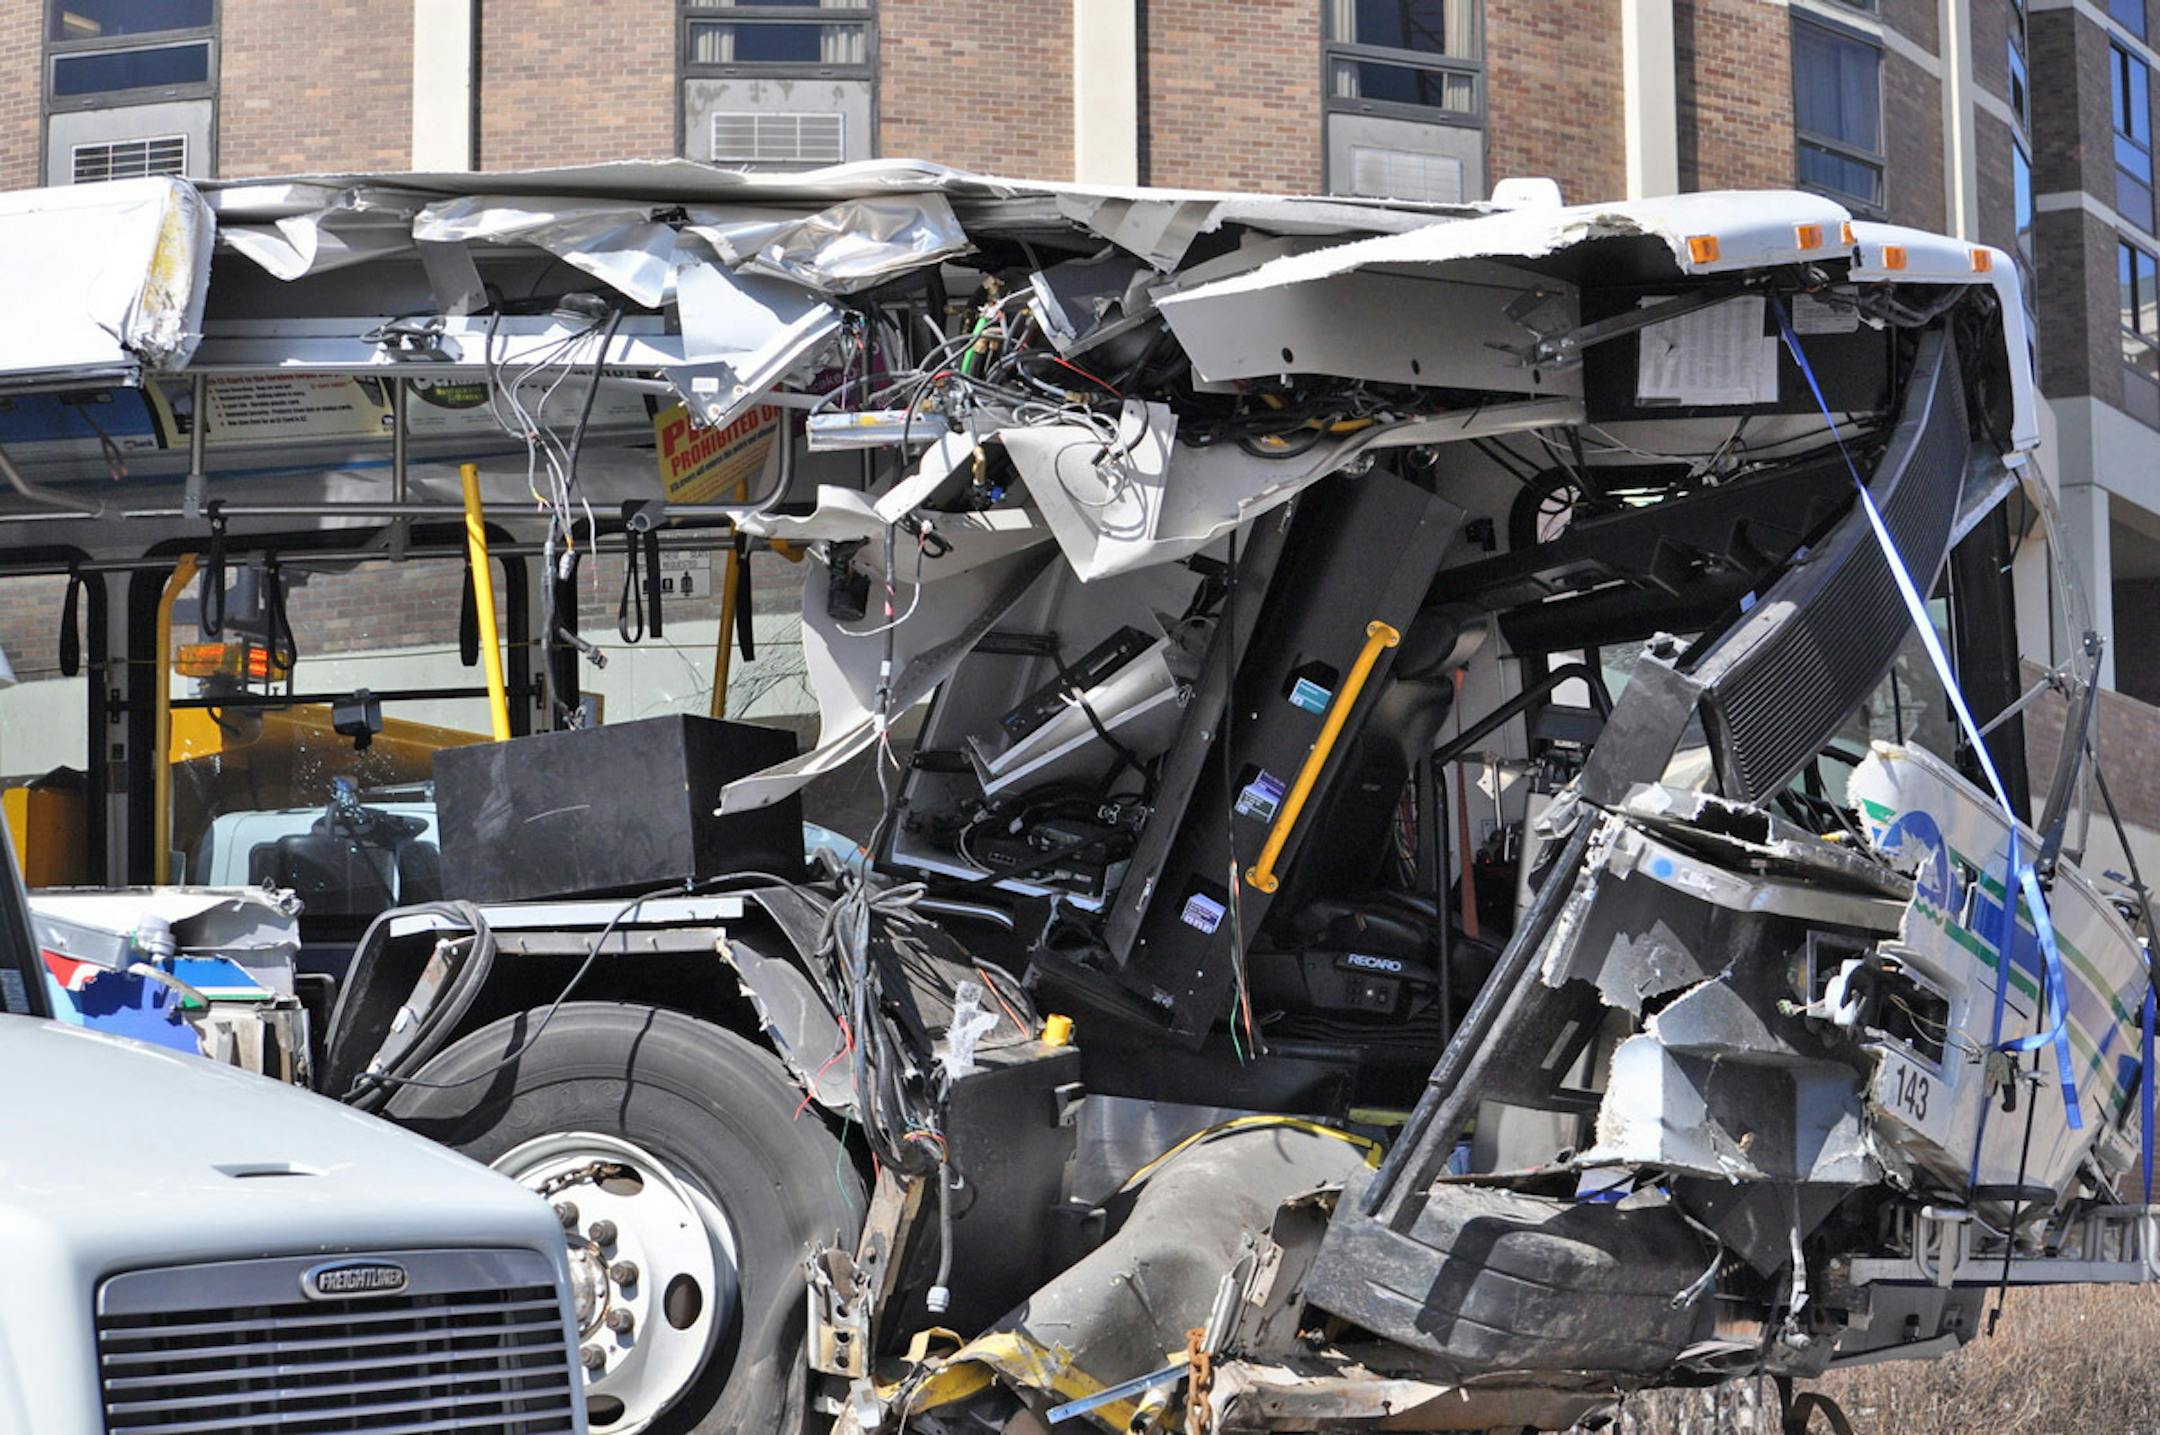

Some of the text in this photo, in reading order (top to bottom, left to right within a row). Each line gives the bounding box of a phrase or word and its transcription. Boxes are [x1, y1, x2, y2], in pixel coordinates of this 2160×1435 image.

[671, 409, 758, 477] PROHIBITED
[1347, 953, 1402, 972] RECARO
[1896, 1063, 1930, 1122] 143
[319, 1267, 403, 1291] FREIGHTLINER
